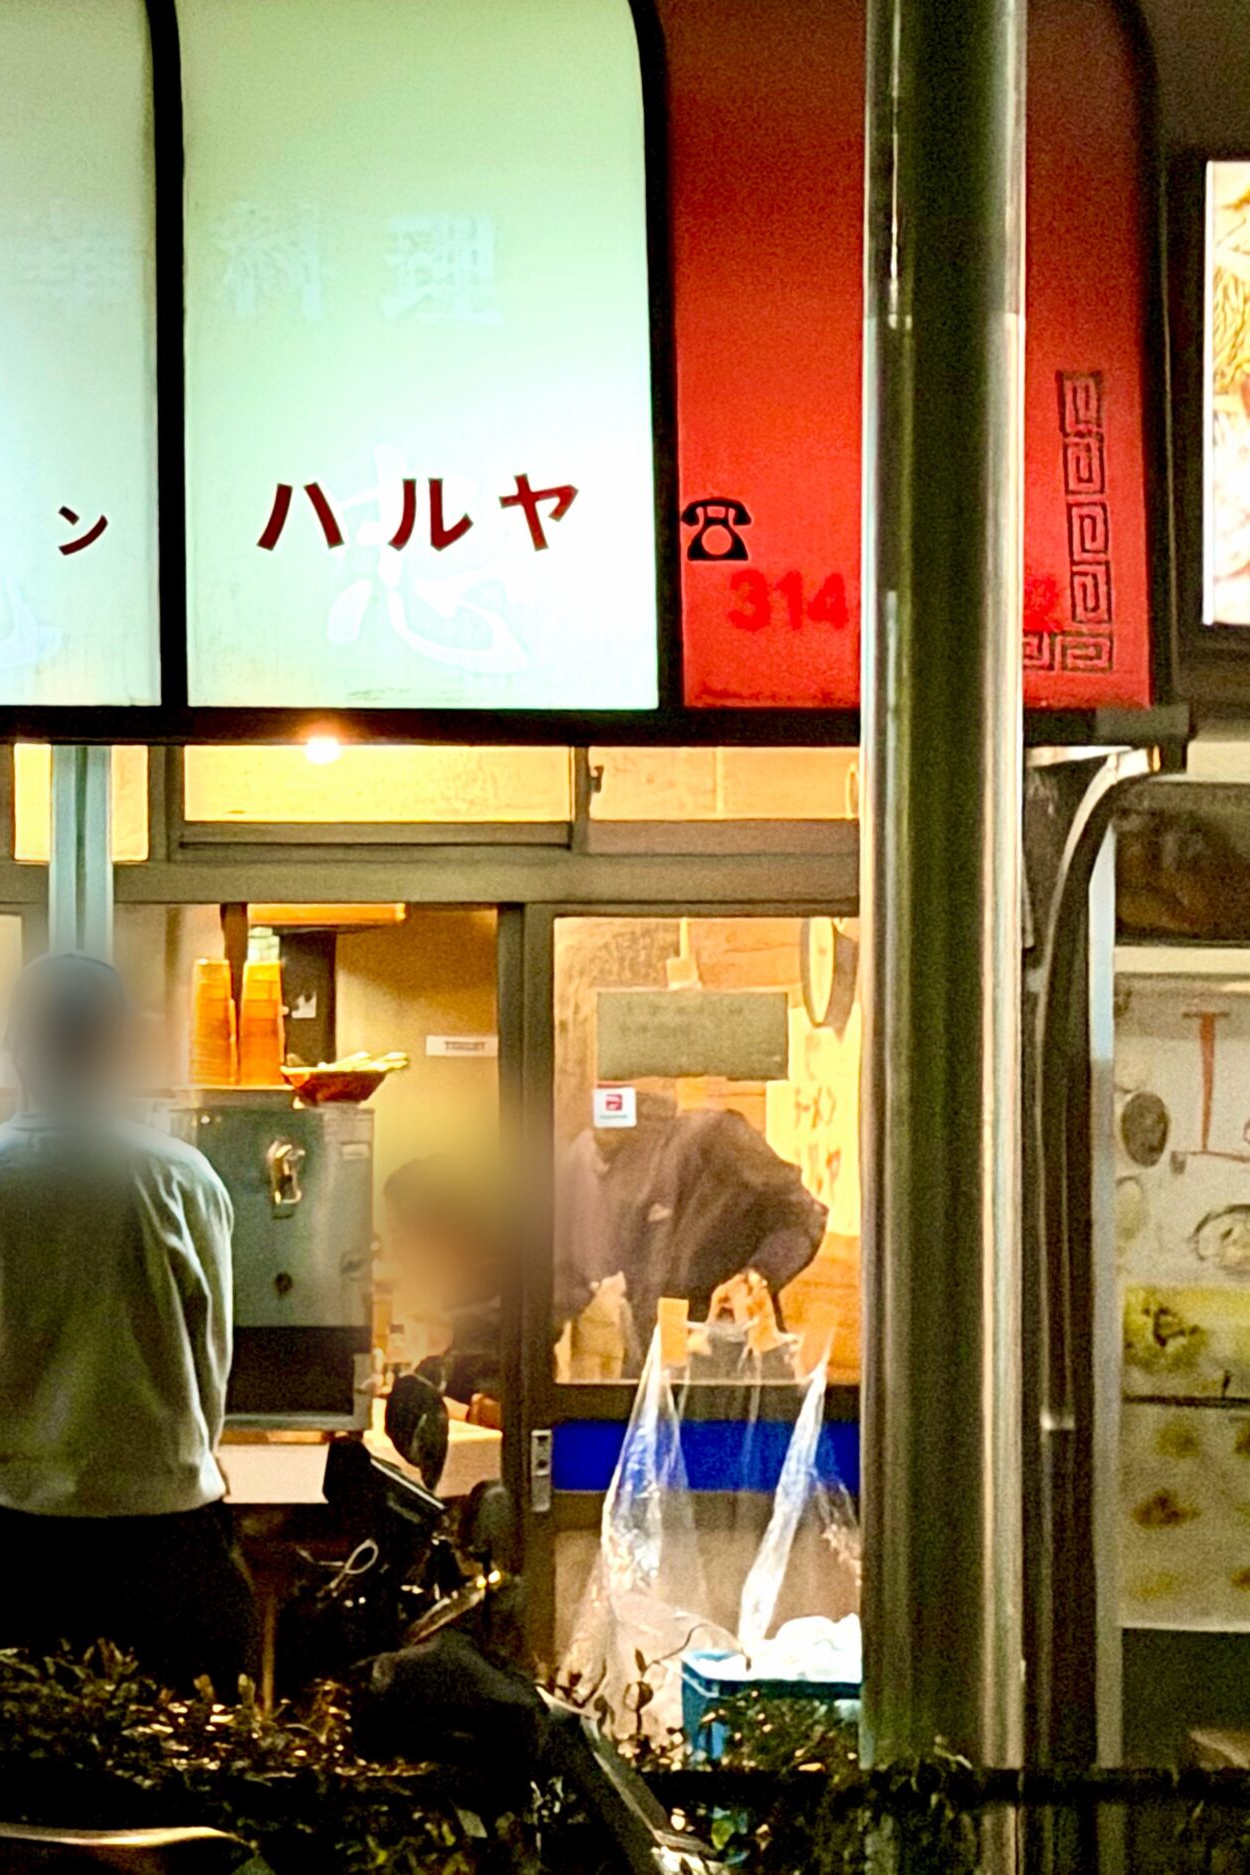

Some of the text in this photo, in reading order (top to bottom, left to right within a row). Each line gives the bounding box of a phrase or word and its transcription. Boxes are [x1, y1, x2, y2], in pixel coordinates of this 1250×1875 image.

[256, 473, 579, 551] ハルヤ
[727, 569, 849, 632] 314
